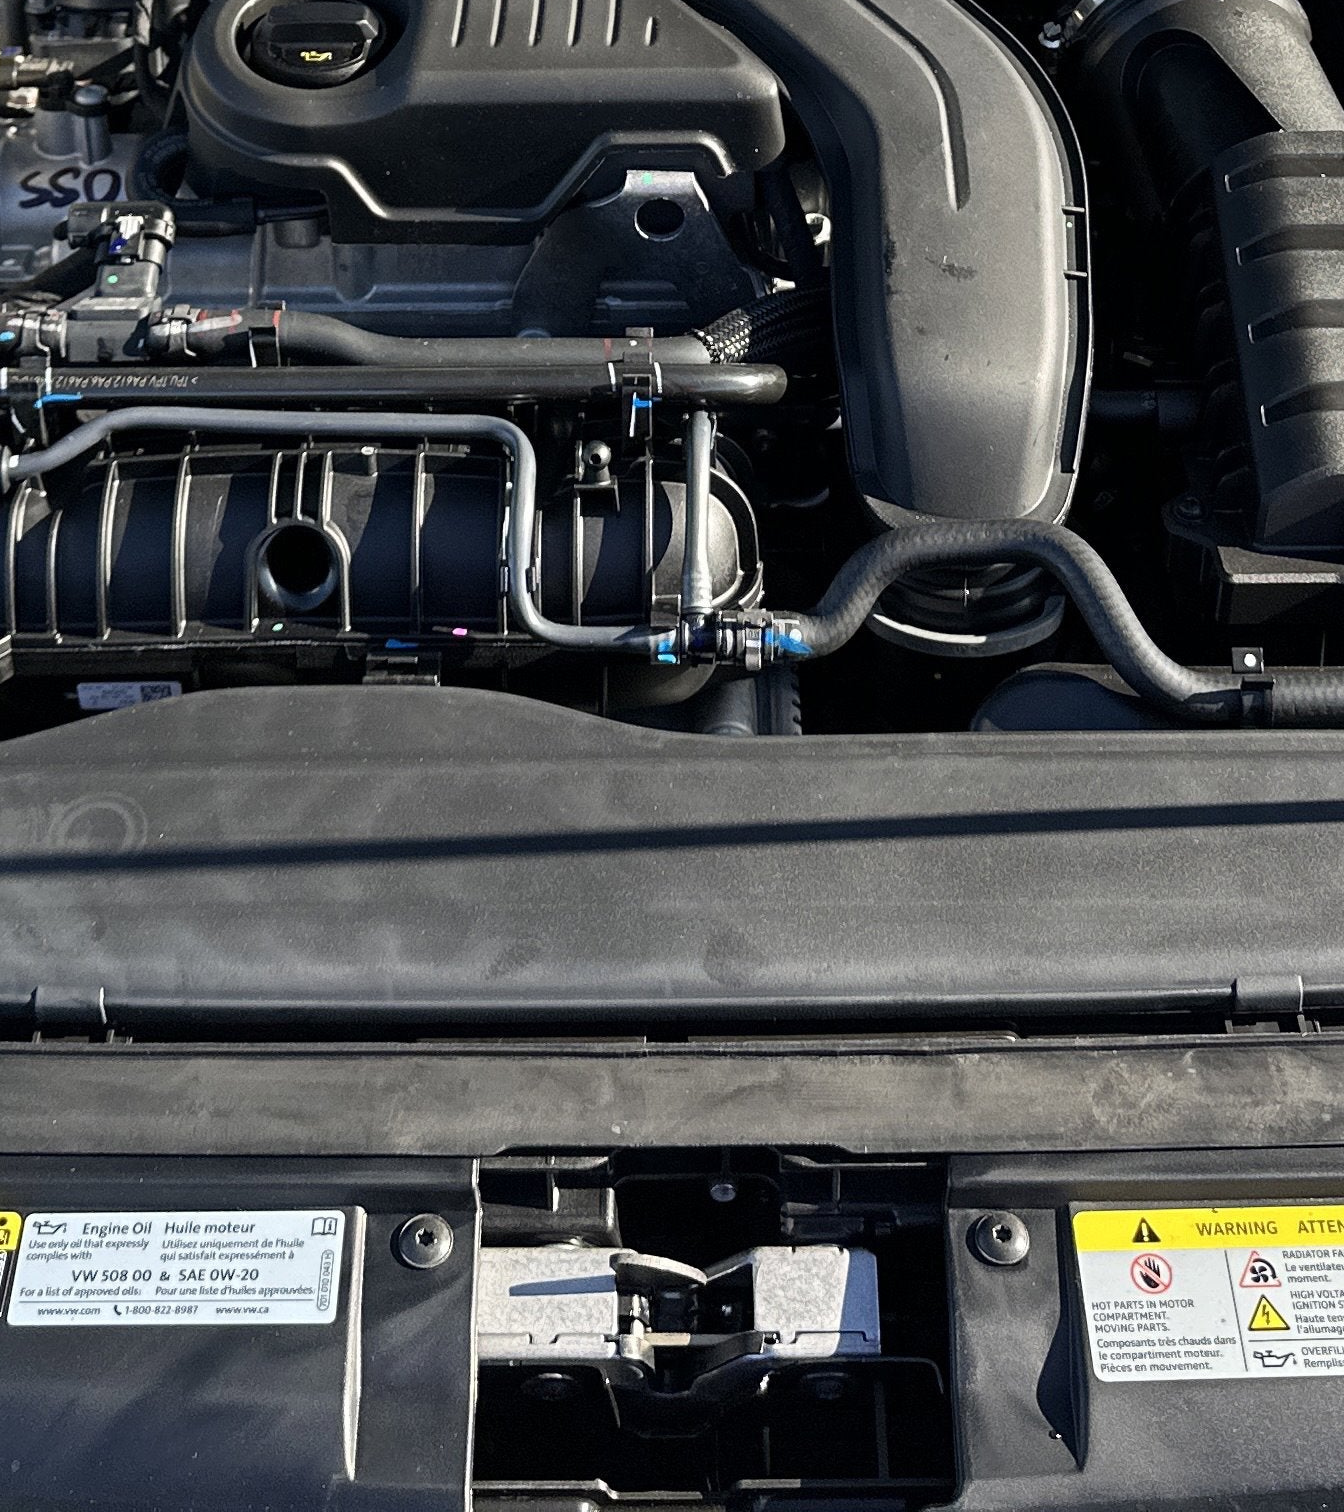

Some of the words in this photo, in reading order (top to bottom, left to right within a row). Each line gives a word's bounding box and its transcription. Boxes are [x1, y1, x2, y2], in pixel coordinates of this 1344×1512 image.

[82, 1222, 129, 1238] Engine
[133, 1221, 152, 1235] Oil
[164, 1221, 200, 1234] Huile
[204, 1223, 255, 1234] moteur
[1196, 1220, 1278, 1236] WARNING
[28, 1240, 46, 1249] Use
[48, 1240, 68, 1250] only
[70, 1239, 82, 1248] oil
[84, 1239, 104, 1248] that
[105, 1238, 149, 1250] expressly
[162, 1239, 198, 1249] Utilisez
[200, 1239, 259, 1250] uniquement
[261, 1238, 273, 1248] de
[26, 1252, 68, 1263] complies
[70, 1251, 92, 1260] with
[160, 1251, 176, 1262] qui
[178, 1250, 216, 1260] satisfait
[219, 1250, 286, 1262] expressément
[288, 1250, 294, 1259] à
[1283, 1250, 1330, 1259] RADIATOR
[1285, 1263, 1296, 1272] Le
[72, 1270, 98, 1282] VW
[101, 1269, 128, 1281] 508
[133, 1269, 152, 1281] 00
[160, 1271, 170, 1281] &
[178, 1269, 206, 1282] SAE
[210, 1268, 259, 1281] 0W-20
[1287, 1274, 1332, 1284] moment.
[20, 1287, 35, 1297] For
[46, 1287, 60, 1296] list
[62, 1287, 73, 1296] of
[74, 1286, 120, 1298] approved
[156, 1286, 177, 1296] Pour
[179, 1287, 197, 1296] une
[199, 1286, 218, 1295] liste
[1290, 1290, 1314, 1299] HIGH
[38, 1307, 100, 1316] www.vw.com
[125, 1304, 199, 1316] 1-800-822-8987
[216, 1306, 269, 1314] www.vw.ca
[1092, 1302, 1111, 1311] HOT
[1114, 1301, 1144, 1309] PARTS
[1146, 1301, 1157, 1309] IN
[1159, 1299, 1194, 1308] MOTOR
[1292, 1301, 1336, 1310] IGNITION
[1093, 1311, 1171, 1321] COMPARTMENT.
[1295, 1313, 1325, 1323] Haute
[1095, 1324, 1135, 1334] MOVING
[1138, 1323, 1171, 1332] PARTS.
[1097, 1338, 1156, 1349] Composants
[1158, 1337, 1176, 1347] très
[1178, 1336, 1212, 1346] chauds
[1214, 1336, 1236, 1345] dans
[1099, 1351, 1107, 1360] le
[1110, 1350, 1182, 1361] compartiment
[1184, 1349, 1224, 1358] moteur.
[1101, 1363, 1132, 1373] Pièces
[1150, 1362, 1213, 1371] mouvement.
